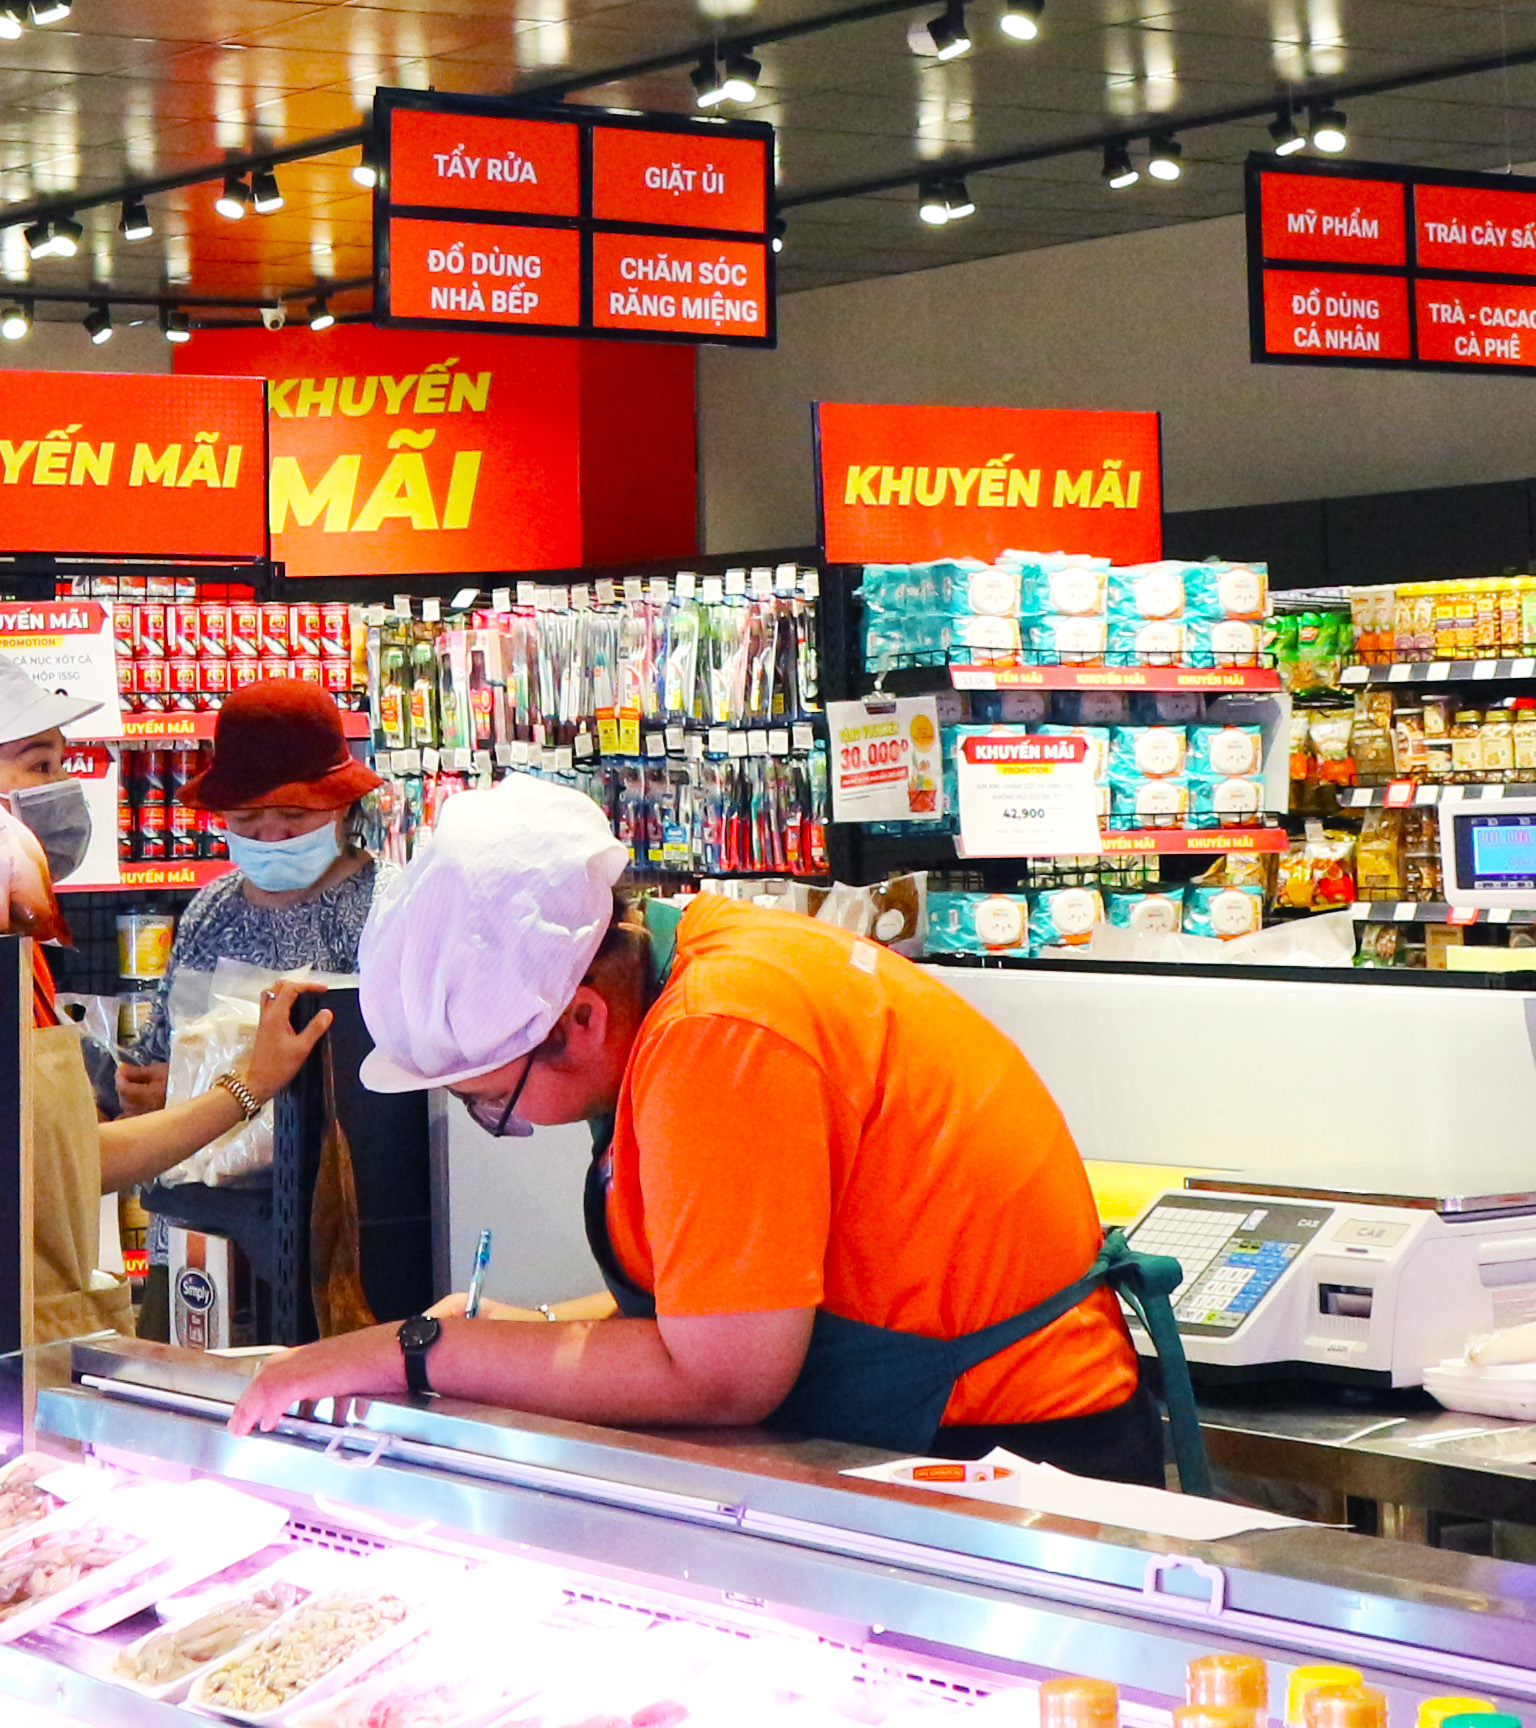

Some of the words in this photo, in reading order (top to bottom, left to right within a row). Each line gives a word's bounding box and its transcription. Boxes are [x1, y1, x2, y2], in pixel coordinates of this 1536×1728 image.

[433, 144, 481, 179] TẨY
[486, 152, 538, 185] RỬA
[645, 162, 697, 197] GIẶT
[702, 165, 725, 194] ỦI
[1287, 209, 1317, 235] MỸ
[1322, 207, 1379, 239] PHẨM
[1425, 218, 1467, 244] TRÁI
[1471, 220, 1507, 246] CÂY
[427, 241, 464, 273] ĐỒ
[471, 246, 541, 278] DÙNG
[620, 253, 693, 283] CHĂM
[698, 257, 747, 287] SÓC
[431, 282, 485, 312] NHÀ
[491, 282, 539, 314] BẾP
[610, 287, 676, 318] RĂNG
[681, 292, 758, 326] MIỆNG
[1292, 288, 1322, 316] ĐỒ
[1325, 291, 1380, 320] DÙNG
[1293, 321, 1321, 348] CÁ
[1325, 325, 1380, 351] NHÂN
[1454, 332, 1481, 357] CÀ
[1485, 335, 1521, 359] PHÊ
[268, 357, 492, 418] KHUYẾN
[129, 431, 242, 488] MÃI
[269, 427, 482, 534] MÃI
[844, 453, 1041, 508] KHUYẾN
[1053, 459, 1141, 510] MÃI
[50, 608, 89, 630] MÃI
[167, 720, 195, 734] MÃI
[976, 739, 1042, 761] KHUYẾN
[1044, 741, 1075, 760] MÃI
[167, 870, 195, 883] MÃI
